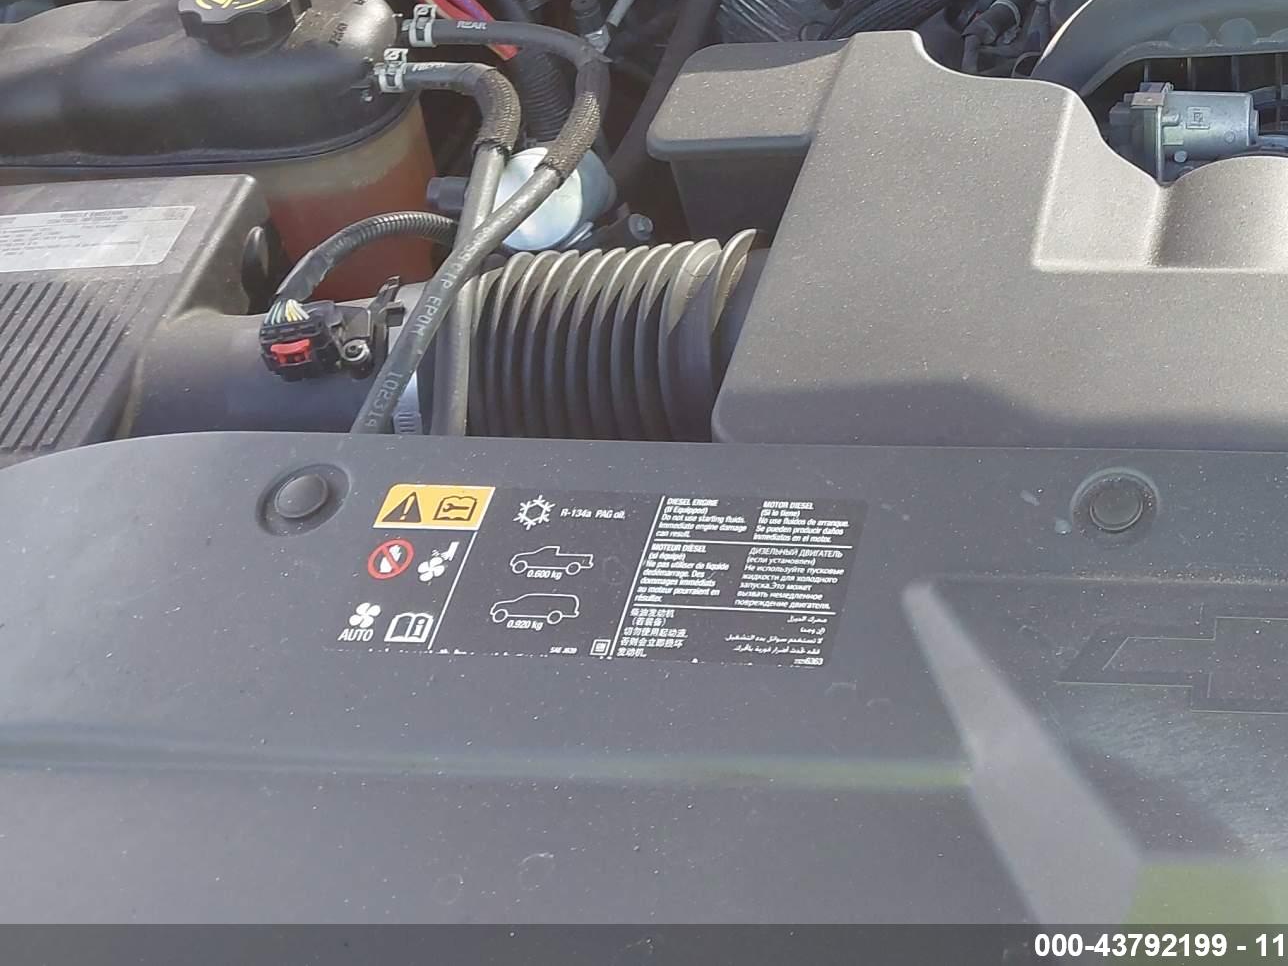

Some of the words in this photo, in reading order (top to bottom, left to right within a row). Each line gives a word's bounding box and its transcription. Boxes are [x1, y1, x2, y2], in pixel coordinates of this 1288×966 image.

[667, 498, 691, 506] DIESEL
[692, 499, 719, 507] ENGINE
[763, 501, 789, 509] MOTOR
[789, 502, 814, 510] DIESEL
[560, 508, 592, 518] R-134a
[595, 509, 613, 518] PAG
[698, 516, 724, 524] starting
[783, 518, 806, 526] fluidos
[807, 518, 816, 526] de
[695, 524, 719, 532] engine
[719, 524, 747, 533] damage
[651, 543, 681, 551] MOTEUR
[748, 548, 798, 556] ДИЗЕЛЬНЫЙ
[799, 549, 843, 558] ДВИГАТЕЛЬ
[706, 562, 729, 570] liquide
[527, 570, 551, 579] 0.600
[551, 570, 562, 580] kg
[691, 570, 705, 578] Des
[640, 577, 679, 586] dommages
[507, 619, 531, 629] 0.920
[531, 620, 544, 631] kg
[337, 628, 374, 642] AUTO
